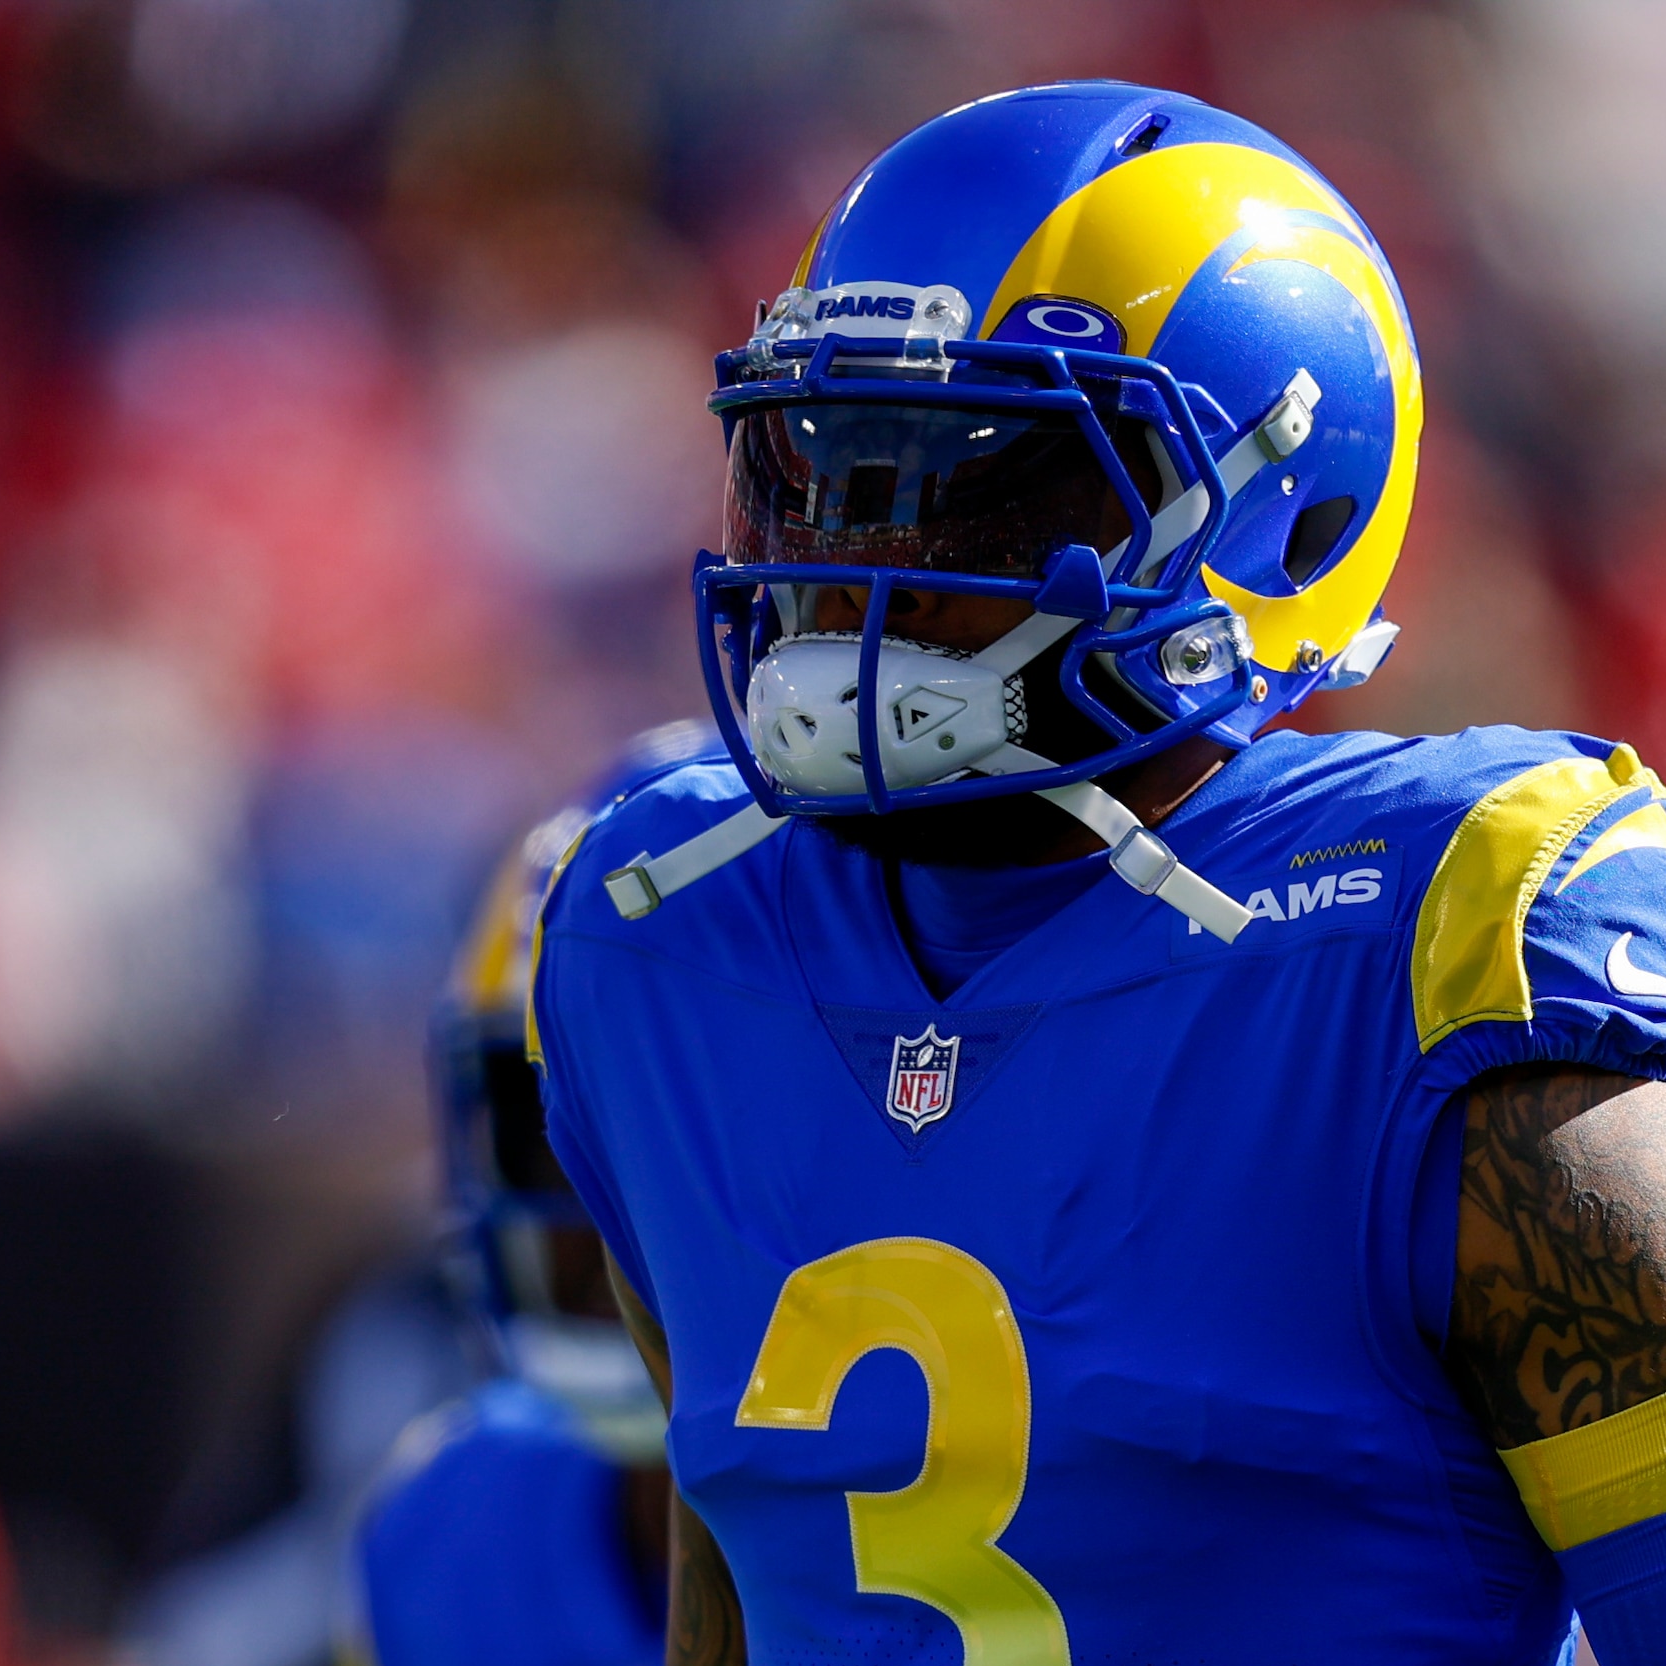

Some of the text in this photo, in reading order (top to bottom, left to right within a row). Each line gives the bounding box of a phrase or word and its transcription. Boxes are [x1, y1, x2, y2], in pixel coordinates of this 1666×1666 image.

[815, 296, 916, 321] RAMS
[1188, 868, 1383, 935] AMS
[897, 1073, 942, 1112] NFL
